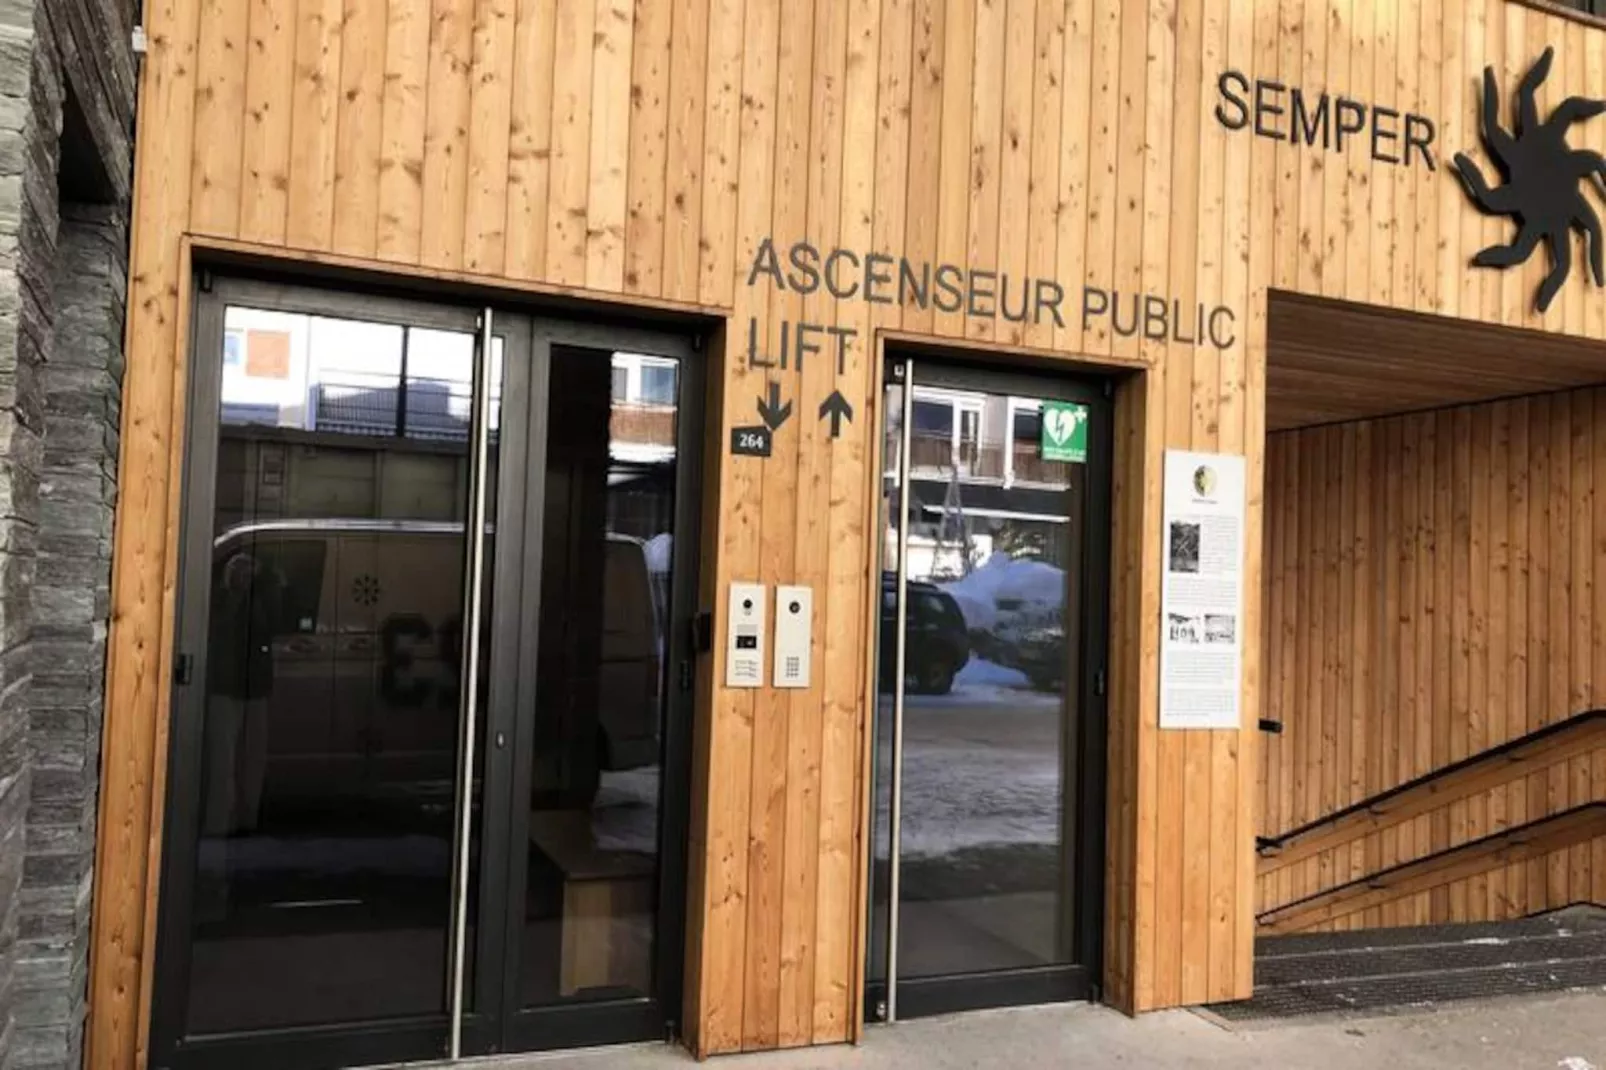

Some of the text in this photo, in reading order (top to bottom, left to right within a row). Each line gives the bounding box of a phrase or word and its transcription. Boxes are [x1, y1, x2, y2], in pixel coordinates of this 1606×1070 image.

[1215, 71, 1436, 171] SEMPER
[748, 238, 1236, 350] ASCENSEUR PUBLIC
[748, 317, 857, 375] LIFT
[740, 433, 764, 449] 264
